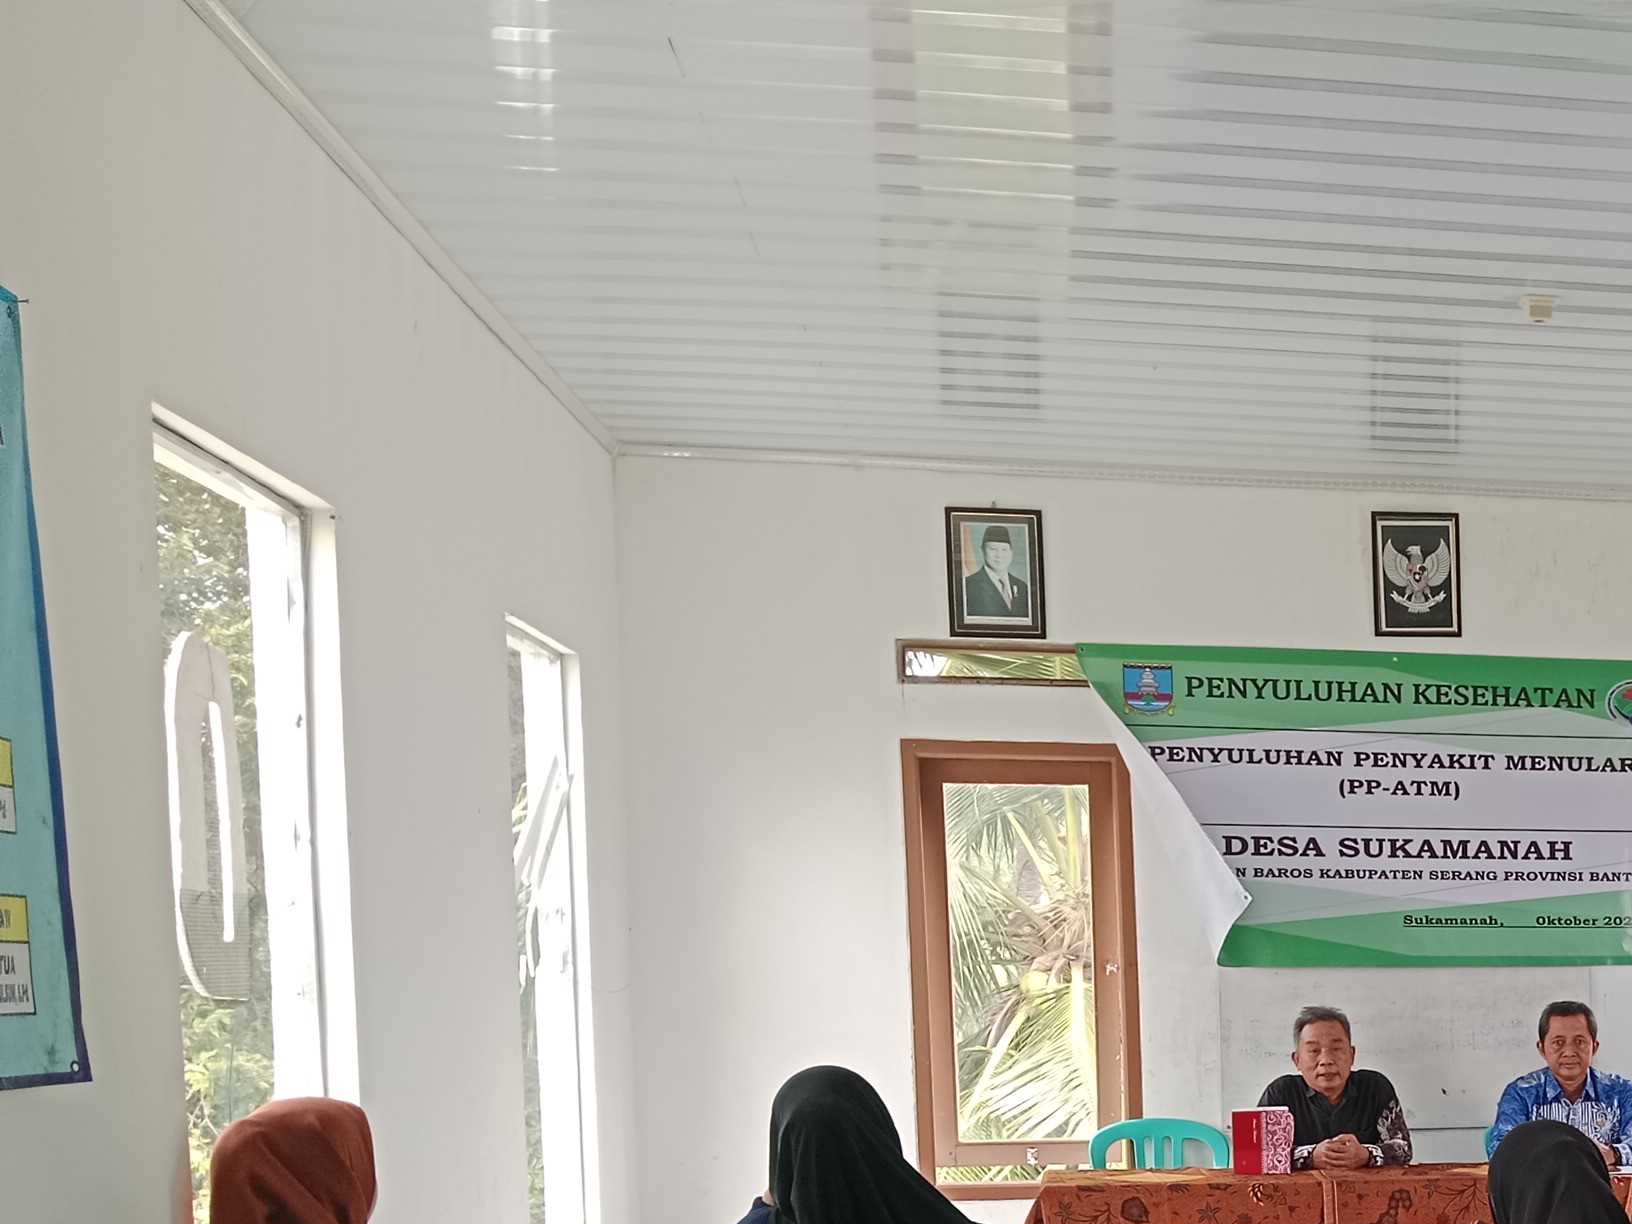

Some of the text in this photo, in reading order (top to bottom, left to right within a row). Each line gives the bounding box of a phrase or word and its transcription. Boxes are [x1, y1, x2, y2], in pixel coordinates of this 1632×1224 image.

[1185, 676, 1596, 709] PENYULUHAN KESEHATAN
[1148, 746, 1343, 767] PENYULUHAN
[1353, 751, 1495, 770] PENYAKIT
[1338, 779, 1461, 800] (PP-ATM)
[1222, 835, 1574, 861] DESA SUKAMANAH
[1253, 867, 1314, 879] BAROS
[1319, 868, 1424, 881] KABUPATEN
[1429, 869, 1499, 881] SERANG
[1504, 870, 1585, 882] PROVINSI
[1403, 915, 1505, 928] Sukamanah,
[1535, 915, 1599, 927] Oktober
